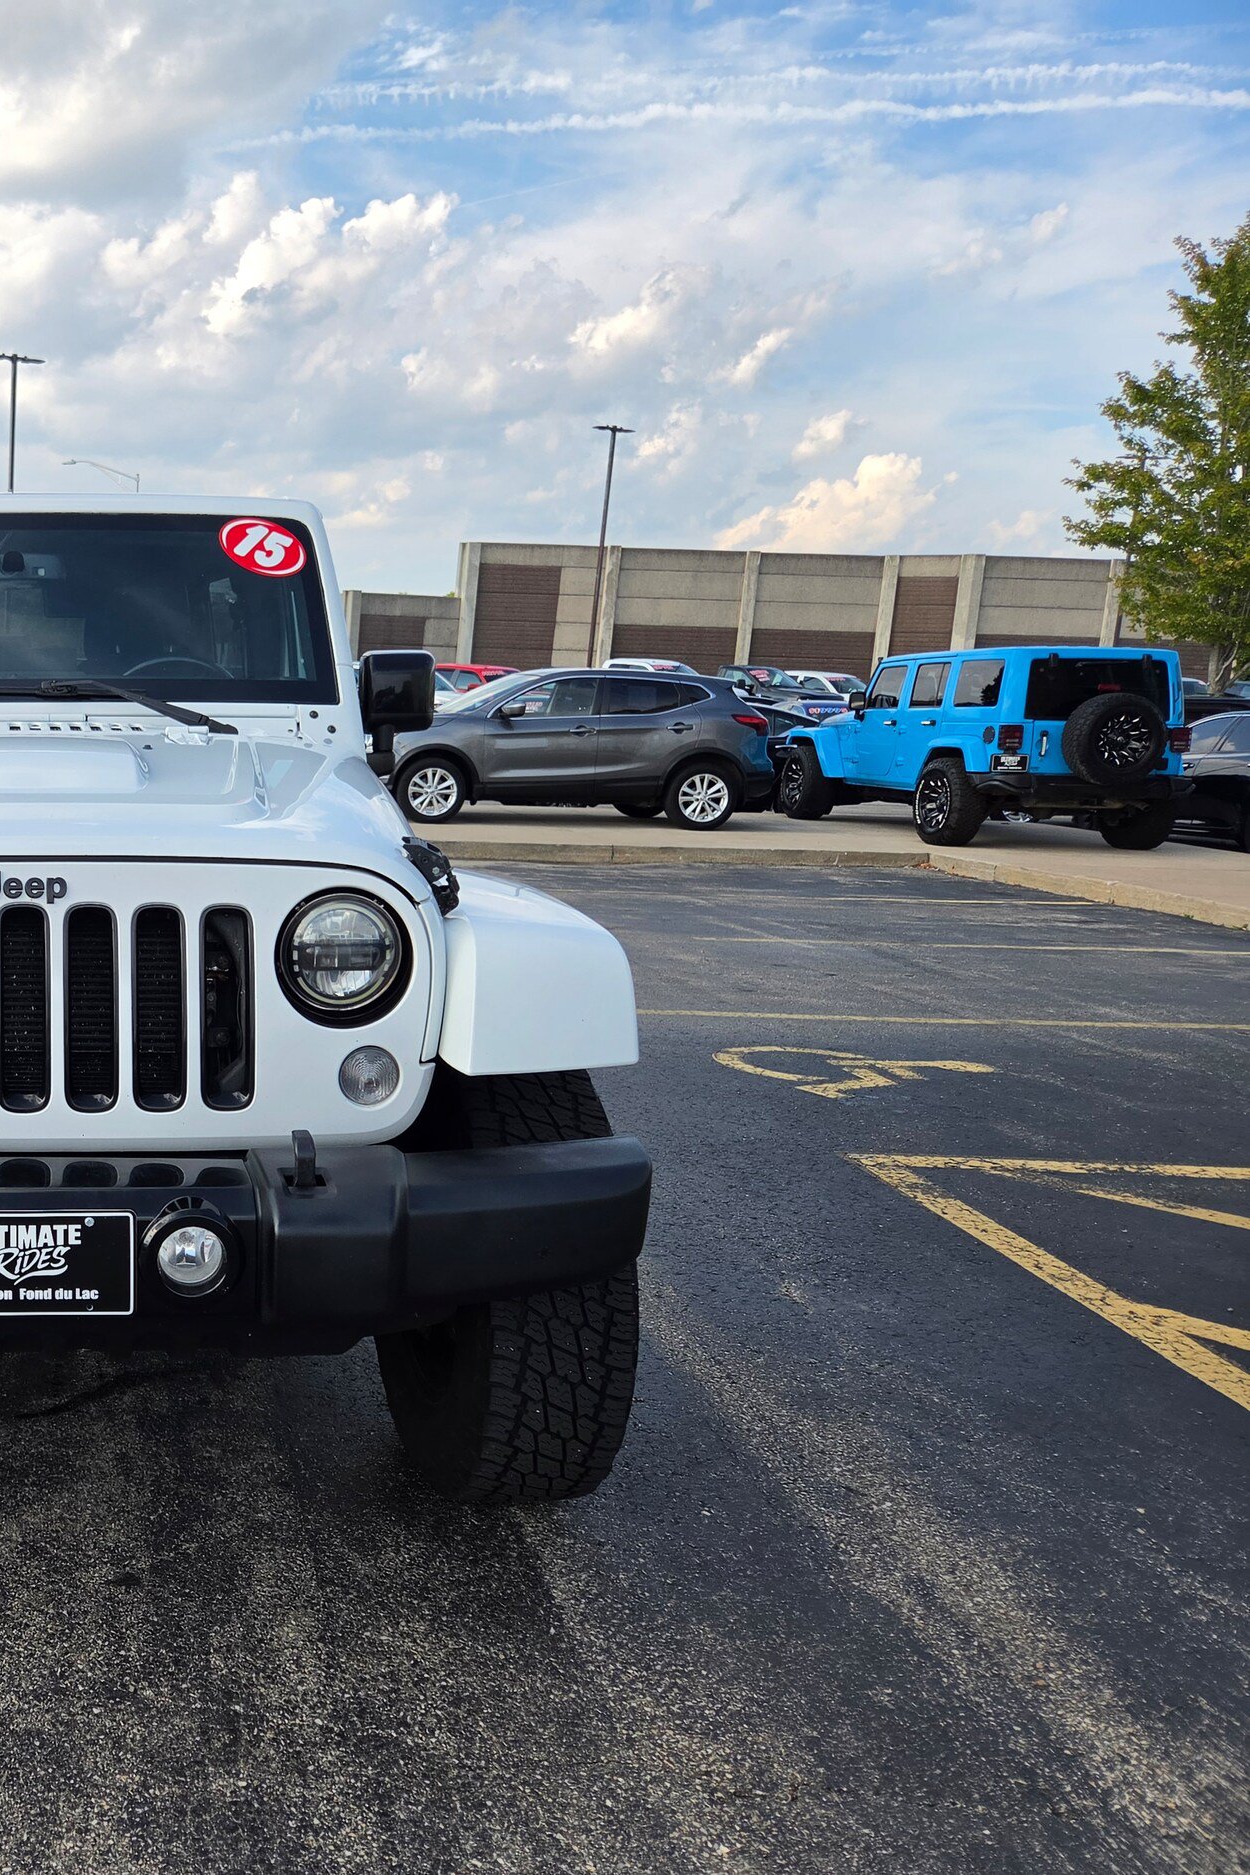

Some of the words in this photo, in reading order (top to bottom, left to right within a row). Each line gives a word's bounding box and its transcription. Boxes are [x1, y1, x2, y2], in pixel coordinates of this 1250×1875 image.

[233, 525, 294, 568] 15
[19, 1287, 52, 1300] Fond
[54, 1287, 74, 1300] du
[75, 1287, 99, 1300] Lac
